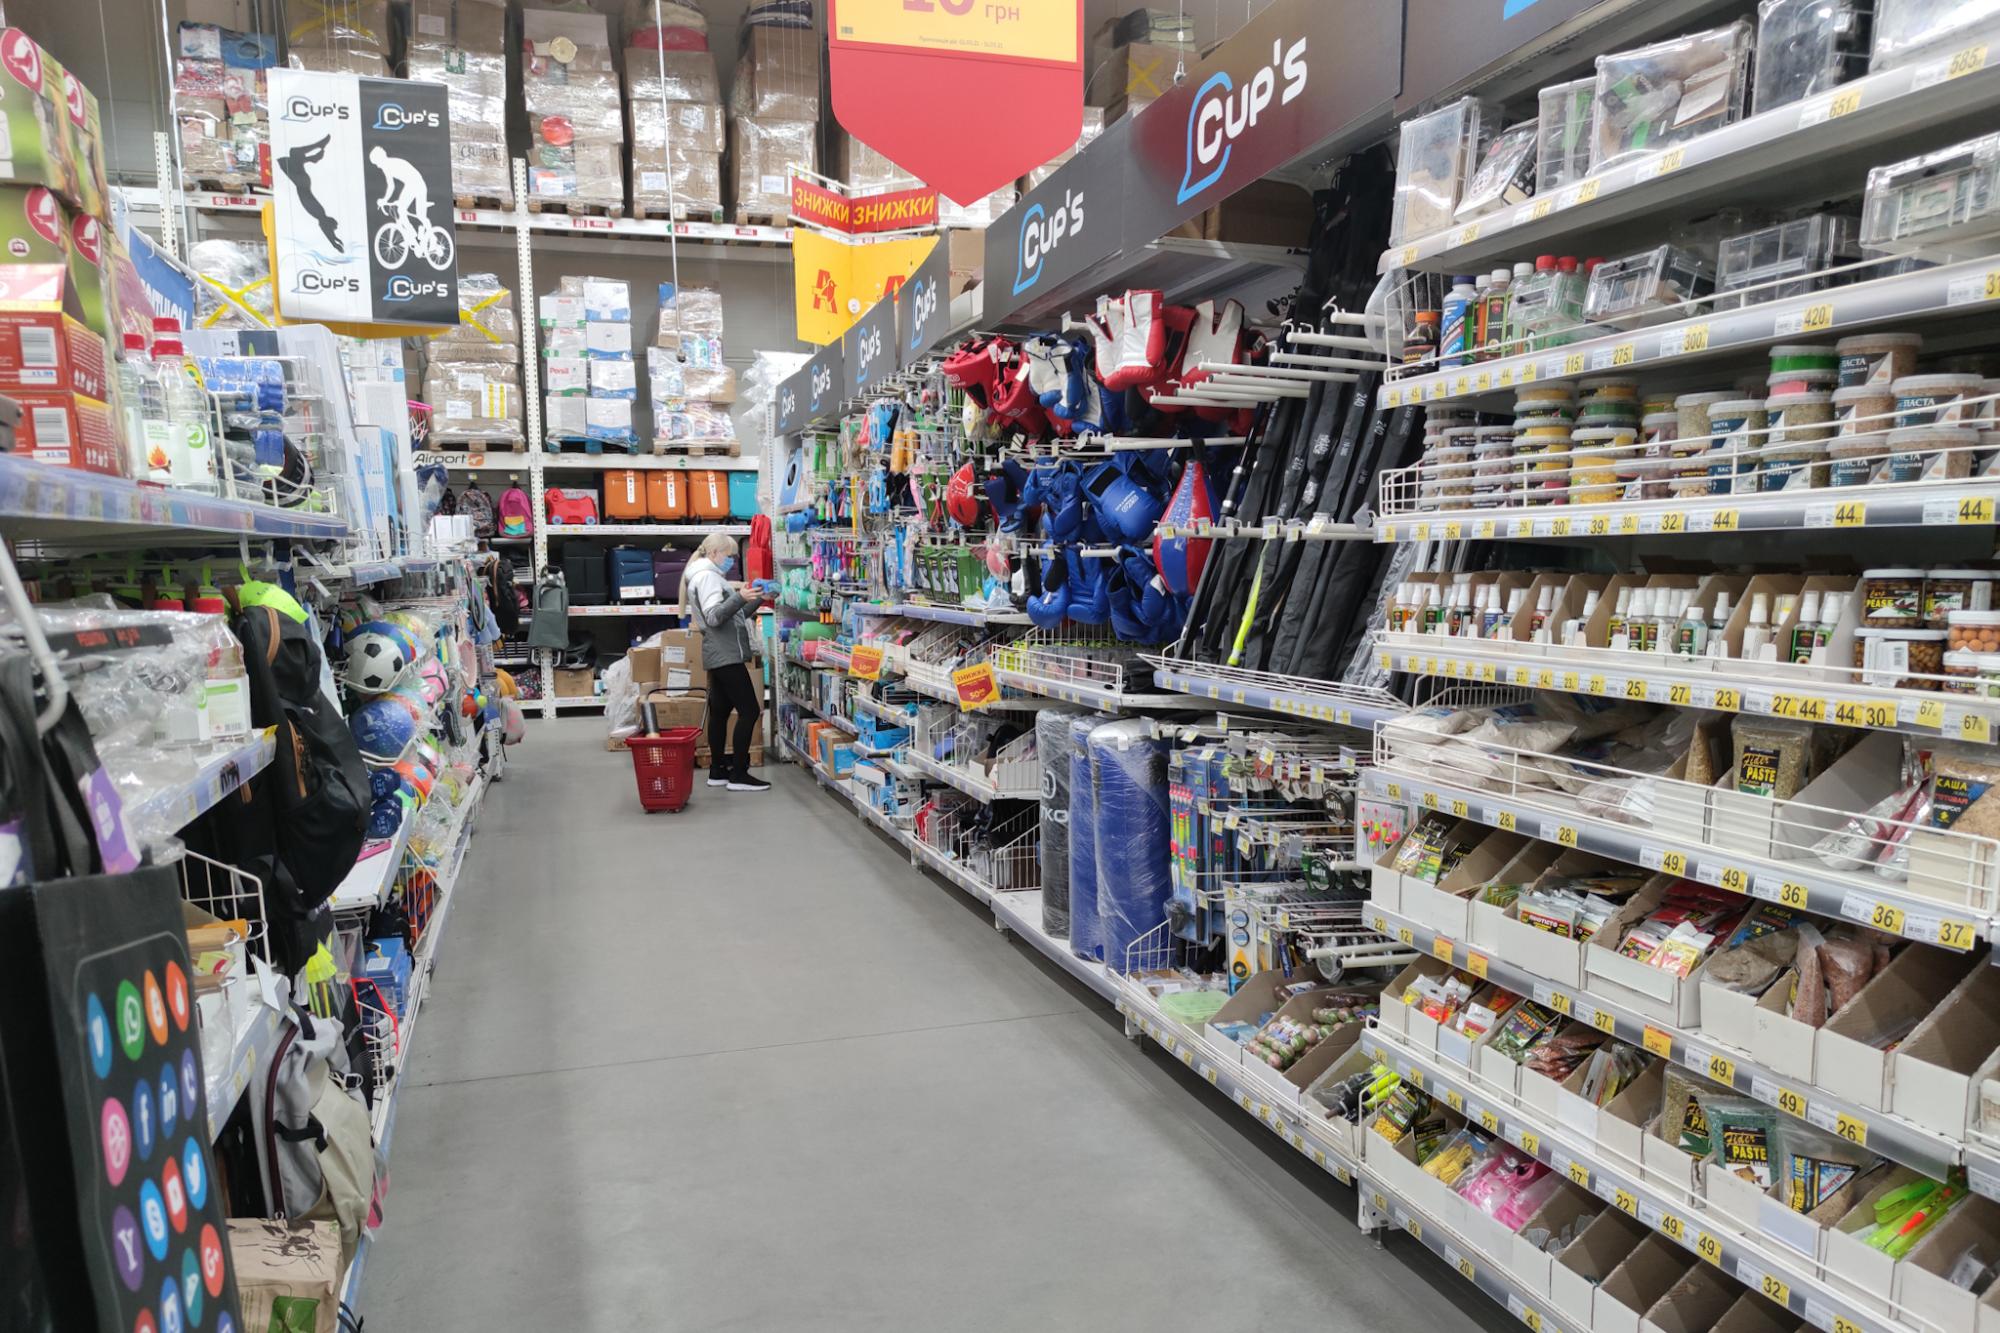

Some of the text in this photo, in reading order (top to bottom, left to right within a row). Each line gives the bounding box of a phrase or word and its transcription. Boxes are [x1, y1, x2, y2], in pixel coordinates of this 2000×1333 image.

[984, 4, 1020, 24] грн
[795, 187, 935, 225] ЗНИЖКИ ЗНИЖКИ
[1803, 306, 1825, 327] 420
[1684, 332, 1702, 350] 300
[1713, 511, 1729, 528] 44
[1835, 506, 1855, 524] 44
[1959, 501, 1981, 521] 44
[1552, 520, 1565, 534] 30
[1590, 519, 1604, 534] 39
[1661, 514, 1678, 530] 32
[957, 668, 988, 682] ЗНИЖКА
[1627, 680, 1641, 696] 25
[1671, 686, 1686, 703] 27
[1716, 690, 1731, 707] 23
[1773, 695, 1790, 715] 27
[1799, 700, 1818, 718] 44
[1836, 704, 1855, 722] 44
[1920, 700, 1933, 715] 67
[1866, 707, 1885, 726] 30
[1964, 715, 1978, 730] 67
[1746, 766, 1777, 783] PASTE
[1936, 778, 1967, 791] КАША
[1453, 802, 1464, 815] 27
[1499, 812, 1512, 827] 28
[1558, 827, 1572, 843] 28
[1663, 853, 1679, 871] 49
[1722, 870, 1740, 887] 49
[1781, 884, 1800, 904] 36
[1873, 906, 1894, 927] 36
[1400, 929, 1409, 942] 12
[1940, 923, 1963, 943] 37
[1552, 993, 1565, 1008] 37
[1594, 1011, 1608, 1028] 37
[1710, 1059, 1728, 1078] 49
[1779, 1092, 1797, 1112] 49
[1837, 1120, 1857, 1140] 26
[1521, 1137, 1533, 1152] 12
[1732, 1145, 1767, 1160] PASTE
[1569, 1168, 1582, 1184] 37
[1616, 1193, 1630, 1210] 22
[1662, 1216, 1678, 1233] 49
[1698, 1237, 1716, 1257] 49
[1459, 1257, 1471, 1275] 20
[1762, 1275, 1781, 1296] 32
